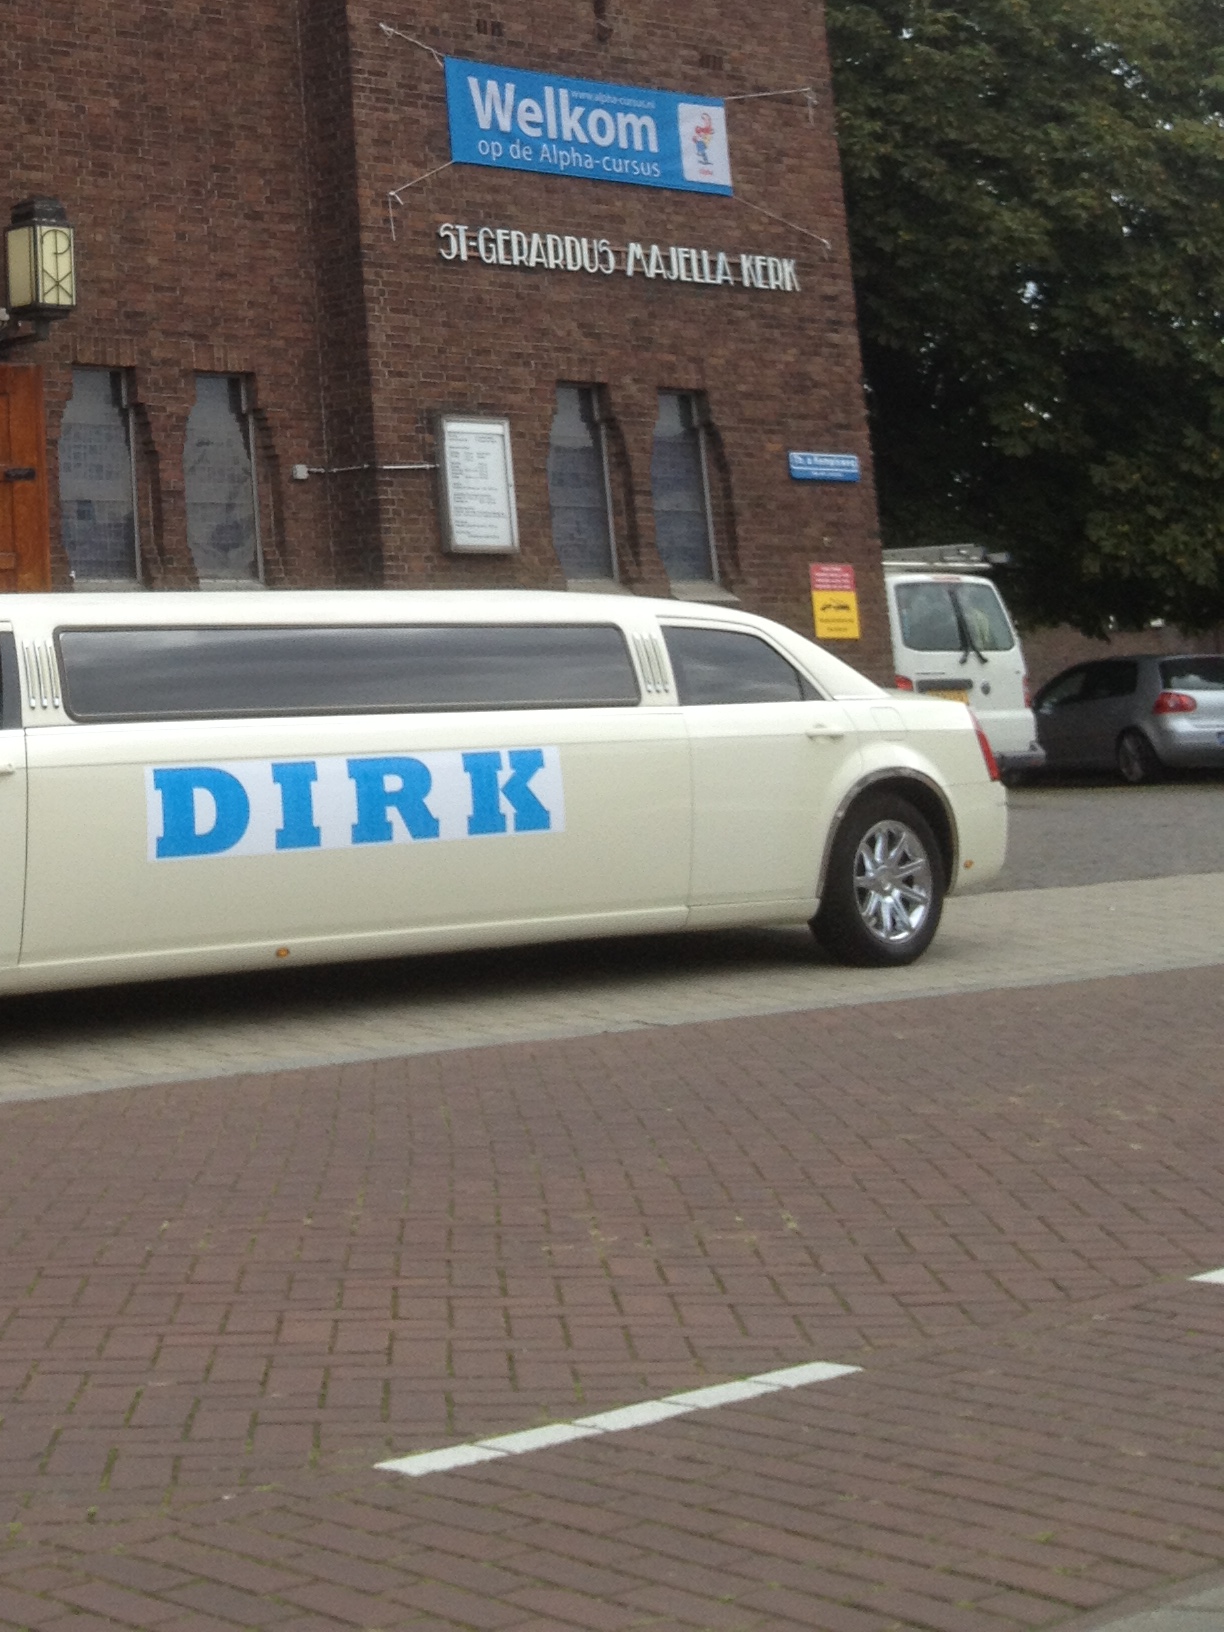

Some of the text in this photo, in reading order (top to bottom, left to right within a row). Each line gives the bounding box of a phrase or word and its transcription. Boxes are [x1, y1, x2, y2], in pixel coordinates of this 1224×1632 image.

[467, 76, 659, 153] Welkom
[478, 138, 661, 178] op de Alpha-cursus
[438, 223, 801, 292] ST-GERARDUS MAJELLA KERK
[153, 749, 551, 859] DIRK
